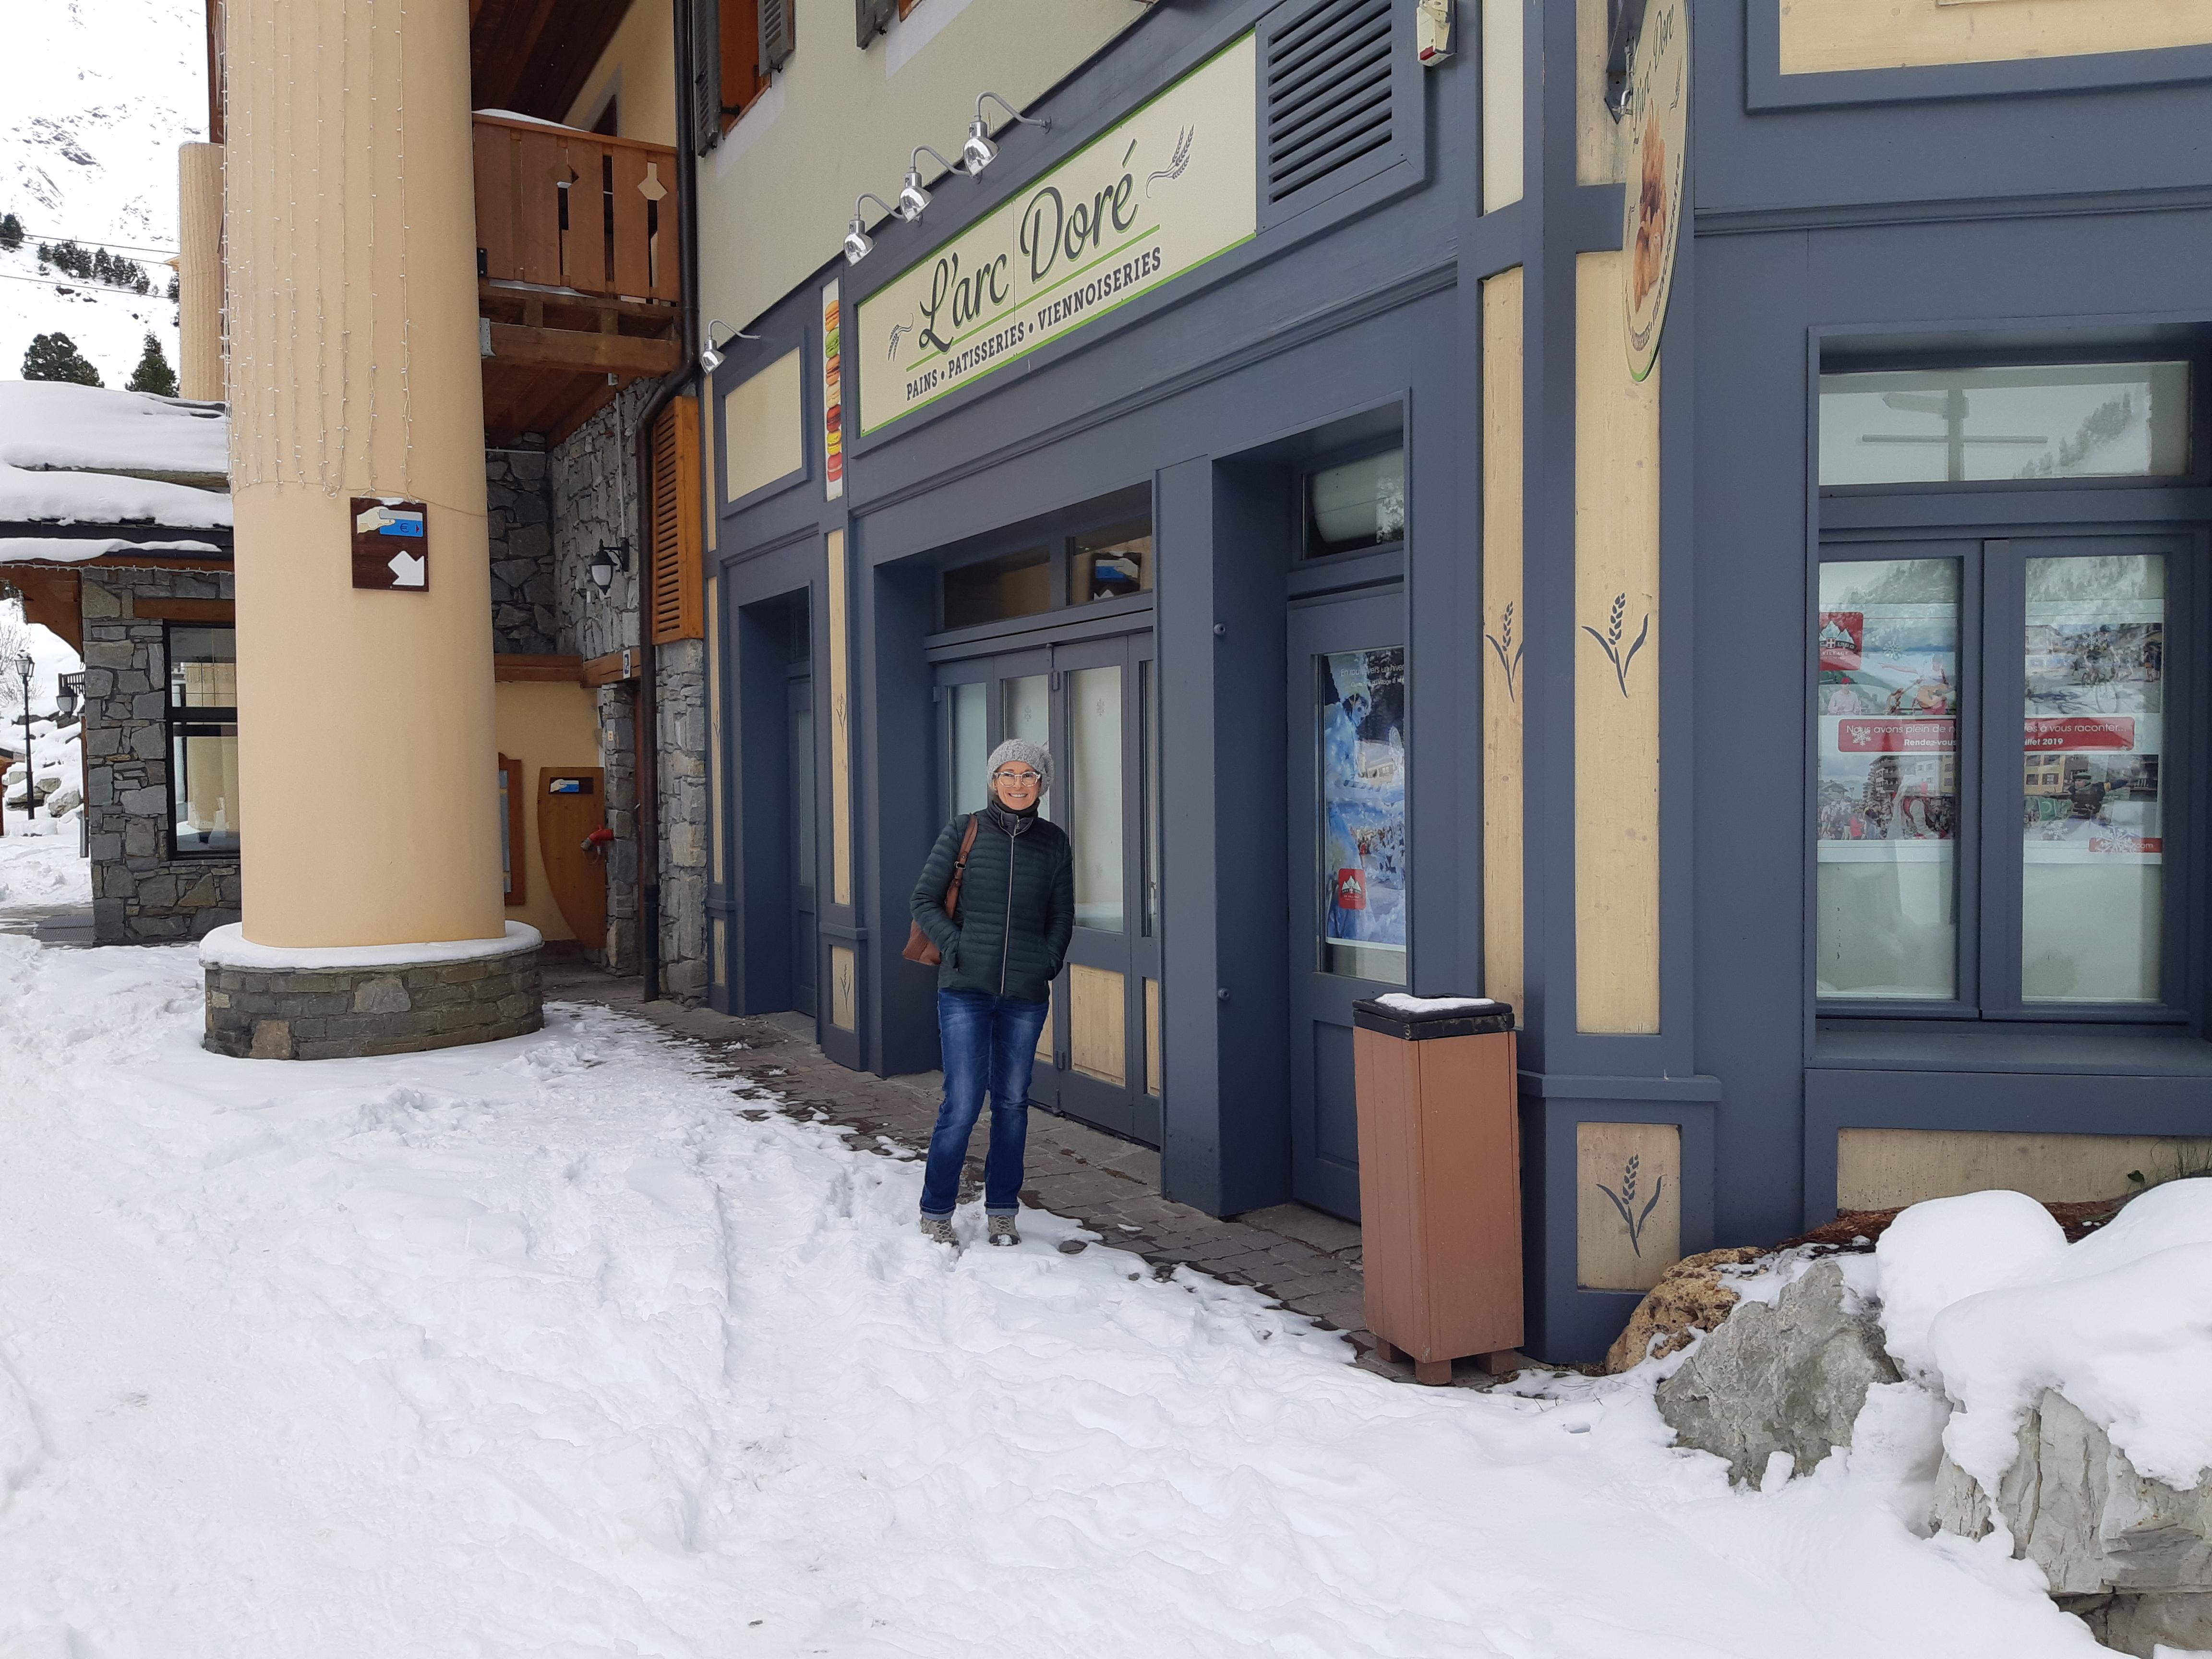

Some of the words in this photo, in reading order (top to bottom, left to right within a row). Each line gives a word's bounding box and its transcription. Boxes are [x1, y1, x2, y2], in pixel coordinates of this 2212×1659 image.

[919, 252, 1010, 355] L'arc
[1020, 138, 1139, 284] Doré
[906, 369, 938, 401] PAINS
[948, 321, 1024, 379] PATISSERIES
[1037, 247, 1161, 331] VIENNOISERIES
[1341, 668, 1348, 676] En
[1905, 724, 1930, 734] plein
[1932, 724, 1947, 733] de
[2074, 723, 2127, 732] raconter...
